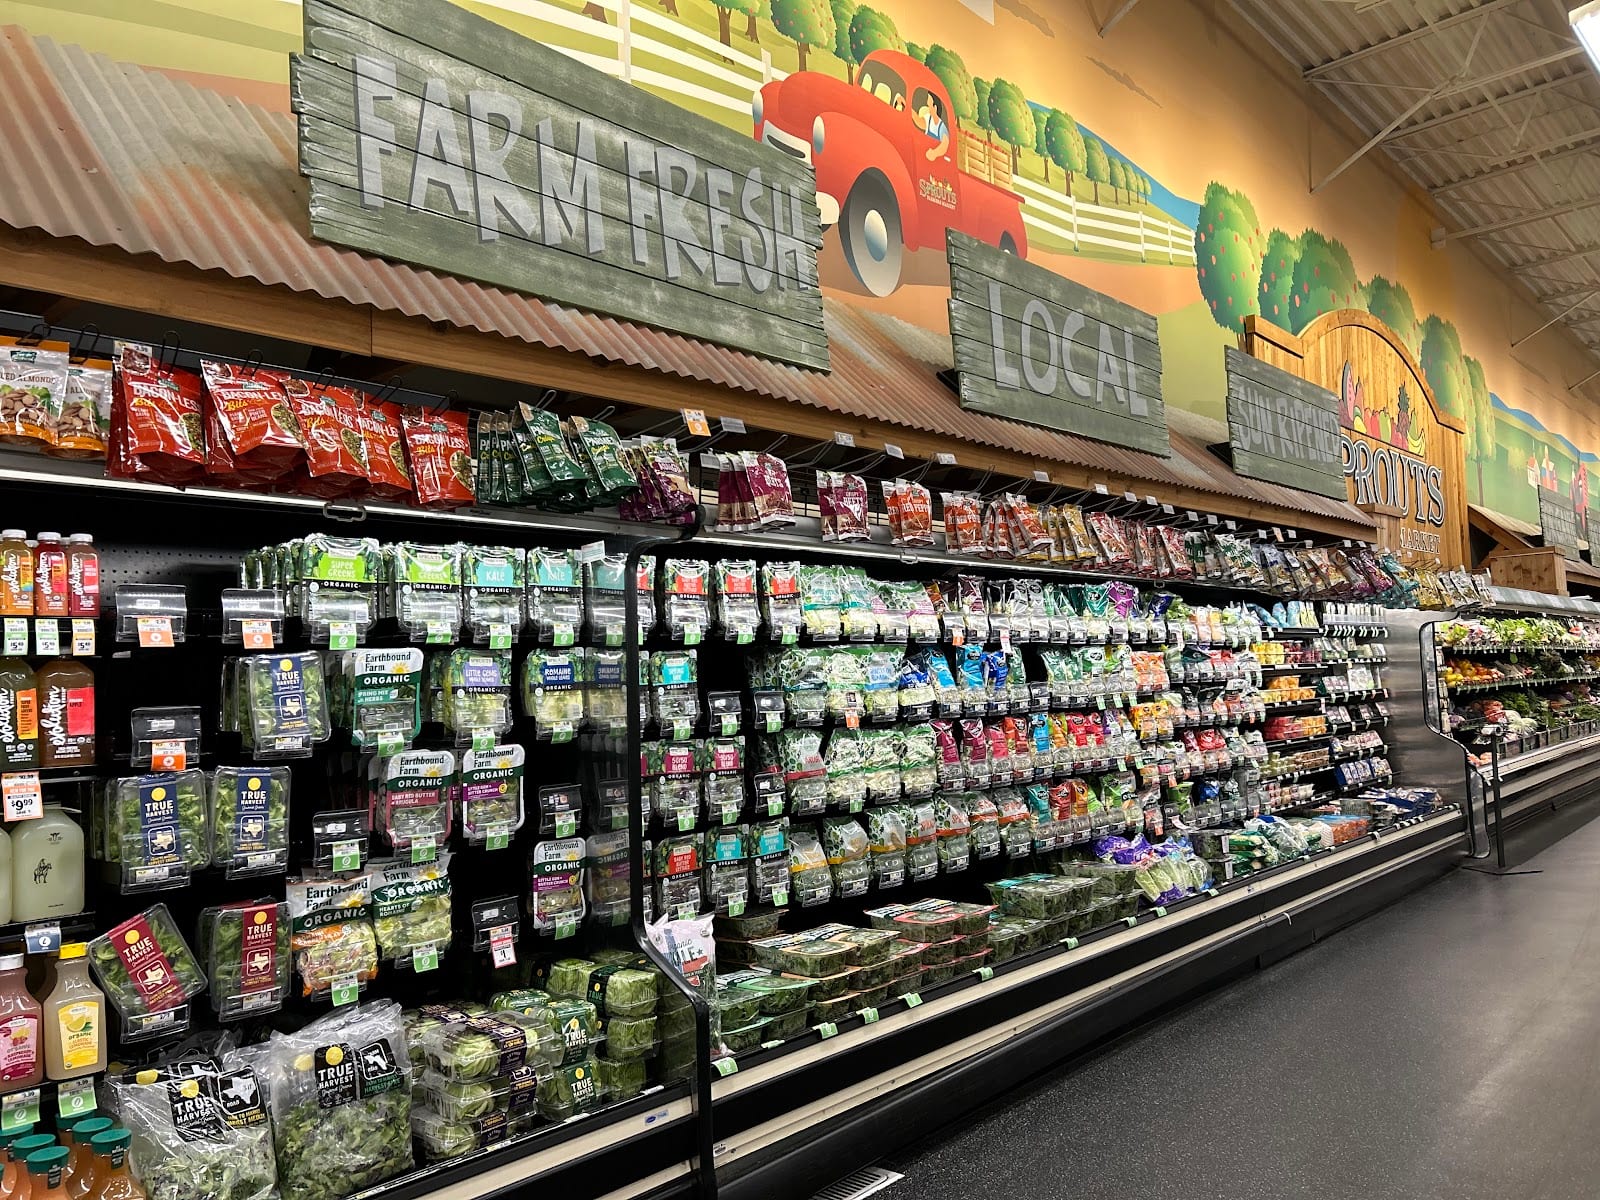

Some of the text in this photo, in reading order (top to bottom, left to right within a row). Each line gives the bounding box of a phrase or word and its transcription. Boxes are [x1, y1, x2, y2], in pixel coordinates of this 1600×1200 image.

[353, 53, 810, 295] FARM FRESH
[918, 178, 957, 205] SPROUTS
[988, 281, 1148, 417] LOCAL
[17, 374, 56, 385] ALMONDS
[227, 400, 248, 411] Bits
[1236, 383, 1341, 464] SUN RIPENED
[1341, 433, 1444, 526] PROUTS
[332, 561, 354, 569] SUPER
[328, 569, 356, 577] GREENS
[486, 572, 504, 581] KALE
[365, 652, 411, 663] Earthbound
[365, 663, 385, 672] Farm
[276, 671, 300, 681] TRUE
[364, 675, 410, 684] ORGANIC
[40, 685, 67, 746] evolution
[474, 747, 514, 759] Earthbound
[400, 756, 445, 766] Earthbound
[473, 760, 492, 768] Farm
[400, 766, 419, 775] Farm
[472, 768, 514, 781] ORGANIC
[398, 778, 442, 788] ORGANIC
[241, 790, 266, 800] TRUE
[144, 800, 174, 812] TRUE
[146, 808, 174, 818] HARVEST
[544, 841, 579, 852] Earthbound
[544, 852, 561, 861] Farm
[544, 861, 580, 872] ORGANIC
[383, 872, 410, 882] Farm
[387, 879, 444, 898] ORGANIC
[380, 904, 400, 912] HEARTS
[304, 909, 366, 928] ORGANIC
[247, 923, 272, 935] TRUE
[246, 932, 272, 941] HARVEST
[123, 937, 152, 958] TRUE
[127, 945, 154, 963] HARVEST
[68, 1032, 92, 1040] organic
[564, 1030, 587, 1042] TRUE
[566, 1037, 588, 1046] HARVEST
[318, 1062, 354, 1080] TRUE
[319, 1074, 354, 1090] HARVEST
[571, 1078, 592, 1089] TRUE
[574, 1086, 594, 1098] HARVEST
[174, 1097, 214, 1116] TRUE
[176, 1108, 215, 1124] HARVEST
